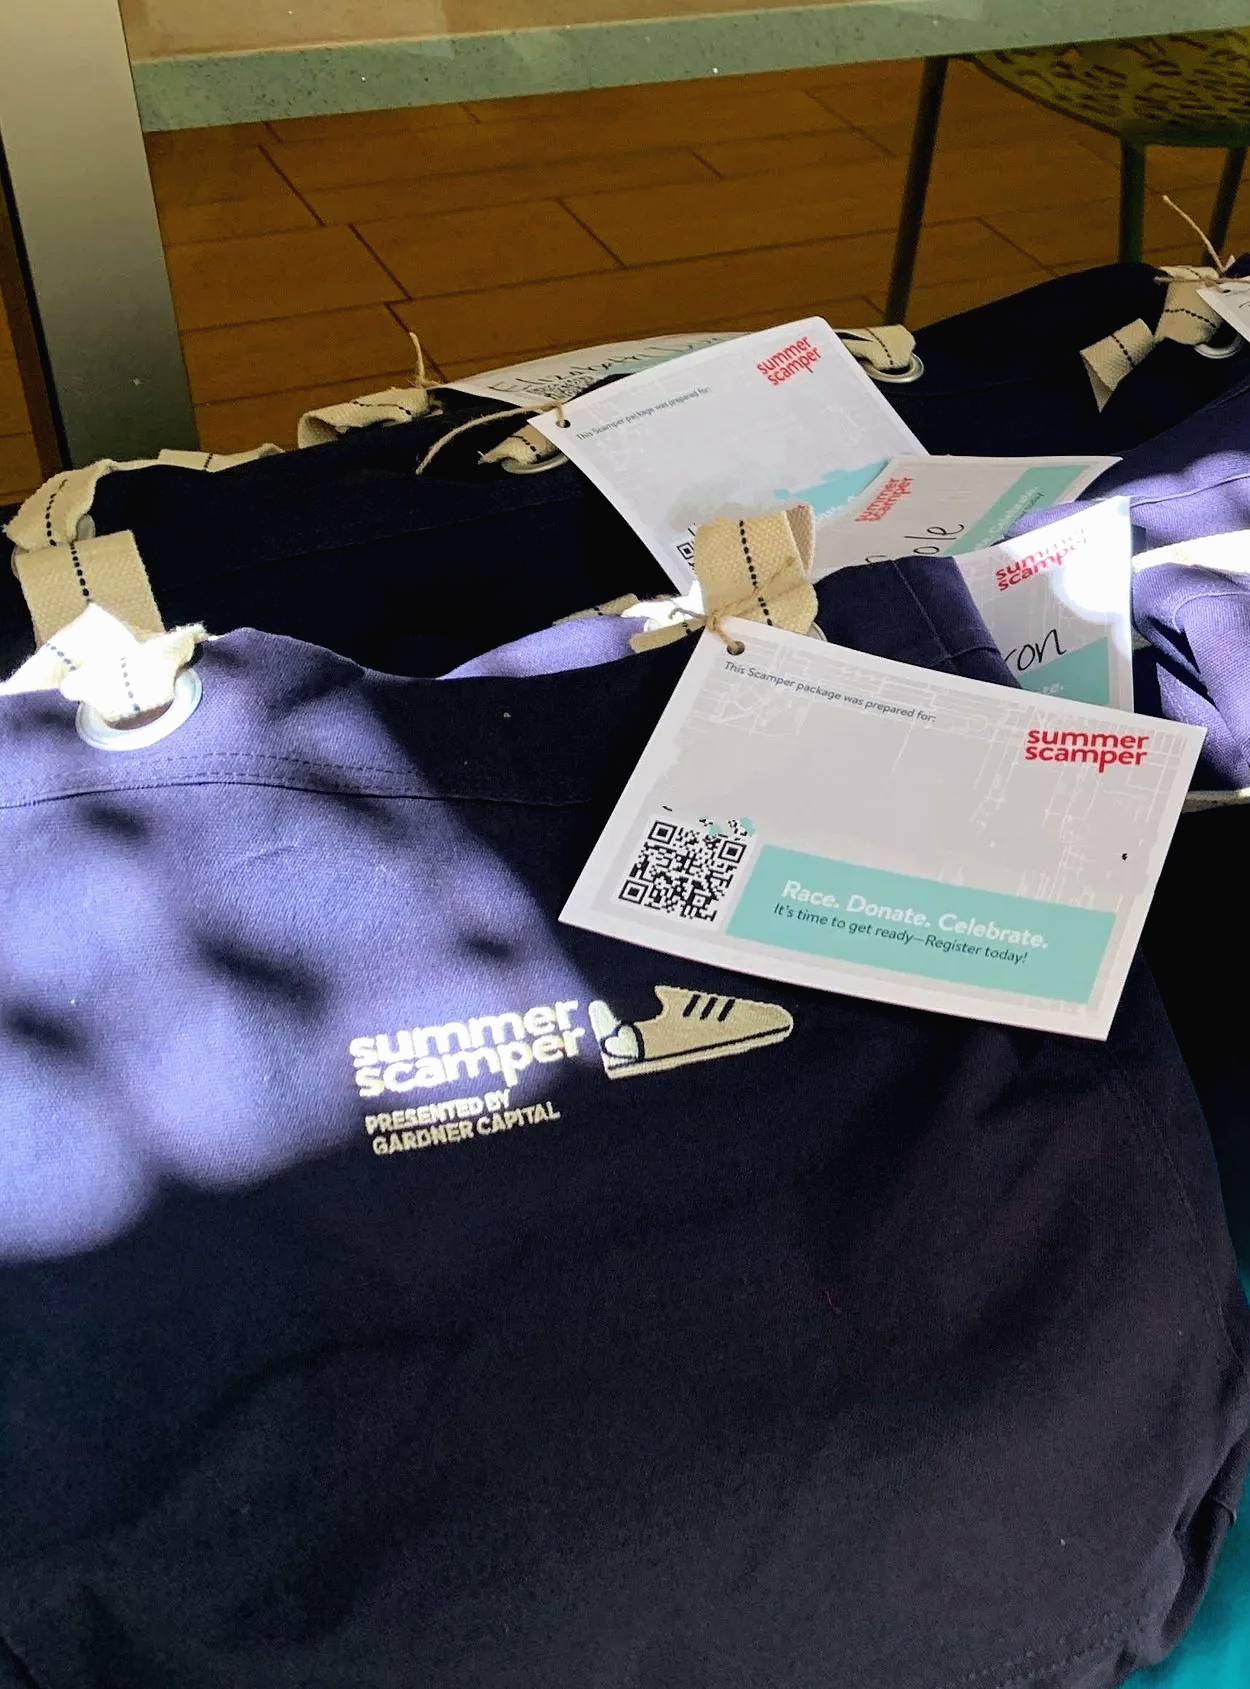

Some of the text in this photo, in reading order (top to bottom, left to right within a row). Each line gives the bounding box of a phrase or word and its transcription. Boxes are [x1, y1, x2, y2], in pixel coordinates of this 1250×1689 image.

[755, 336, 812, 375] summer
[766, 347, 822, 387] scamper
[724, 661, 936, 723] This Scamper package was prepared for:
[1024, 745, 1148, 774] scamper
[1026, 729, 1150, 750] summer
[781, 879, 1049, 950] Race. Donate. Celebrate.
[797, 908, 829, 926] time
[831, 915, 846, 929] to
[847, 920, 872, 938] get
[984, 946, 1028, 966] today!
[349, 999, 579, 1068] summer
[355, 1026, 585, 1098] scamper
[364, 1088, 511, 1135] PRESENTED BY
[372, 1100, 561, 1156] GARDNER CAPITAL
